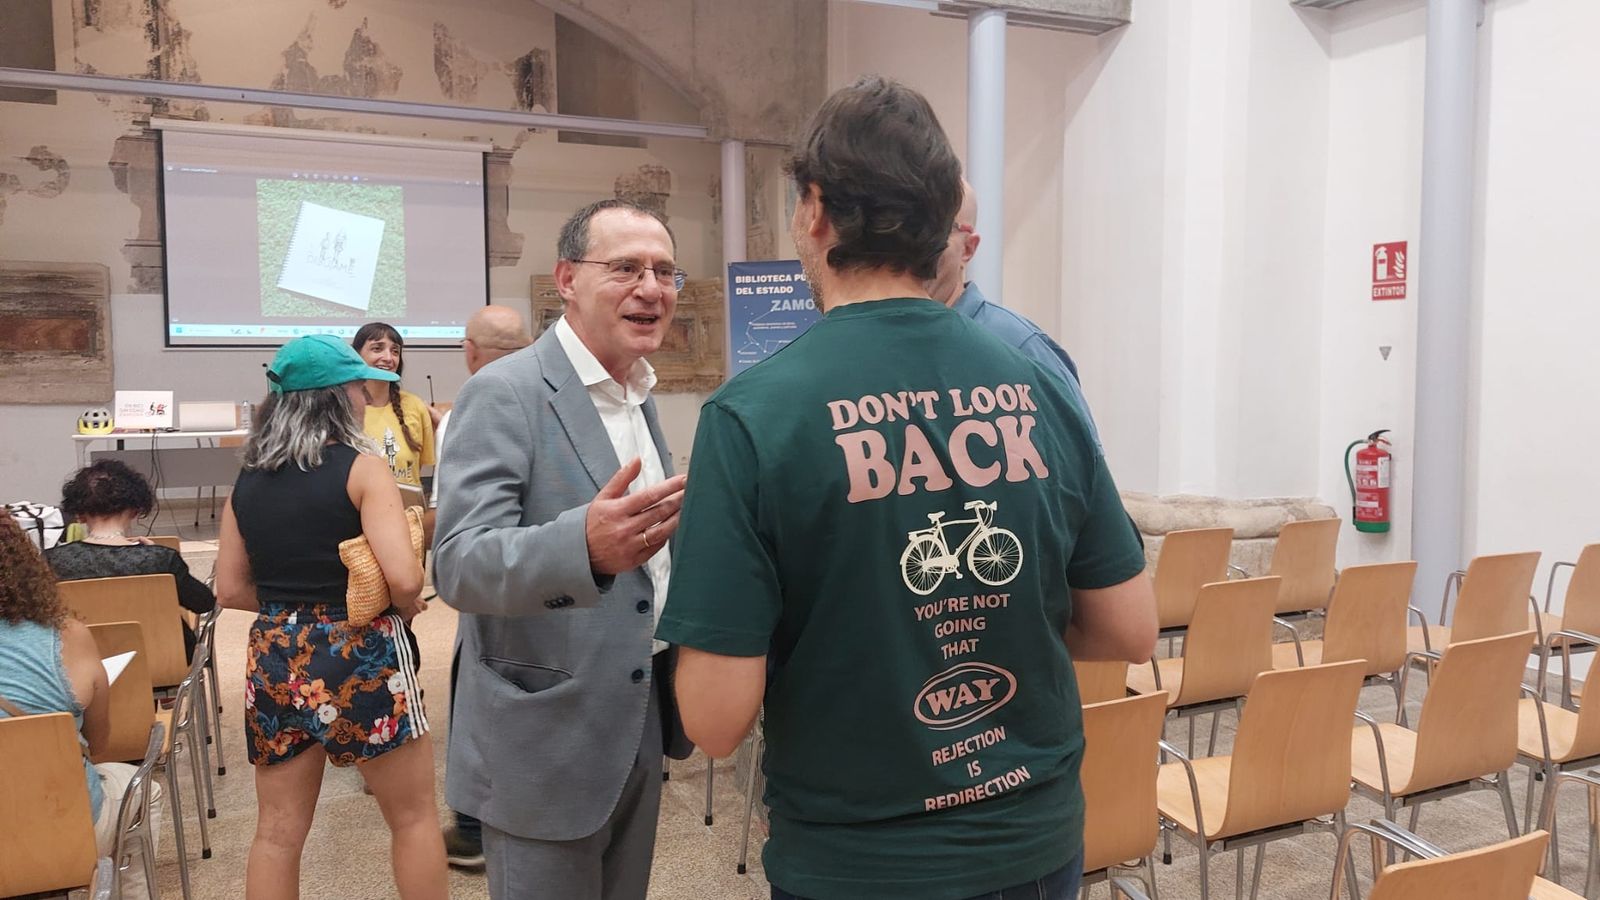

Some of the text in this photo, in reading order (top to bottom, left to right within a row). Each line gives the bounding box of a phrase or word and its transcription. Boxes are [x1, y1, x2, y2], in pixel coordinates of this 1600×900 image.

[735, 274, 792, 284] BIBLIOTECA
[736, 286, 794, 295] DEL ESTADO
[1373, 286, 1405, 297] EXTINTOR
[771, 298, 815, 311] ZAMO
[827, 384, 1038, 430] DON'T LOOK
[835, 415, 1049, 504] BACK
[914, 593, 1011, 621] YOU'RE NOT
[934, 616, 986, 638] GOING
[941, 638, 979, 660] THAT
[925, 678, 1001, 716] WAY
[932, 726, 1006, 766] REJECTION
[967, 760, 982, 778] IS
[925, 766, 1031, 811] REDIRECTION
